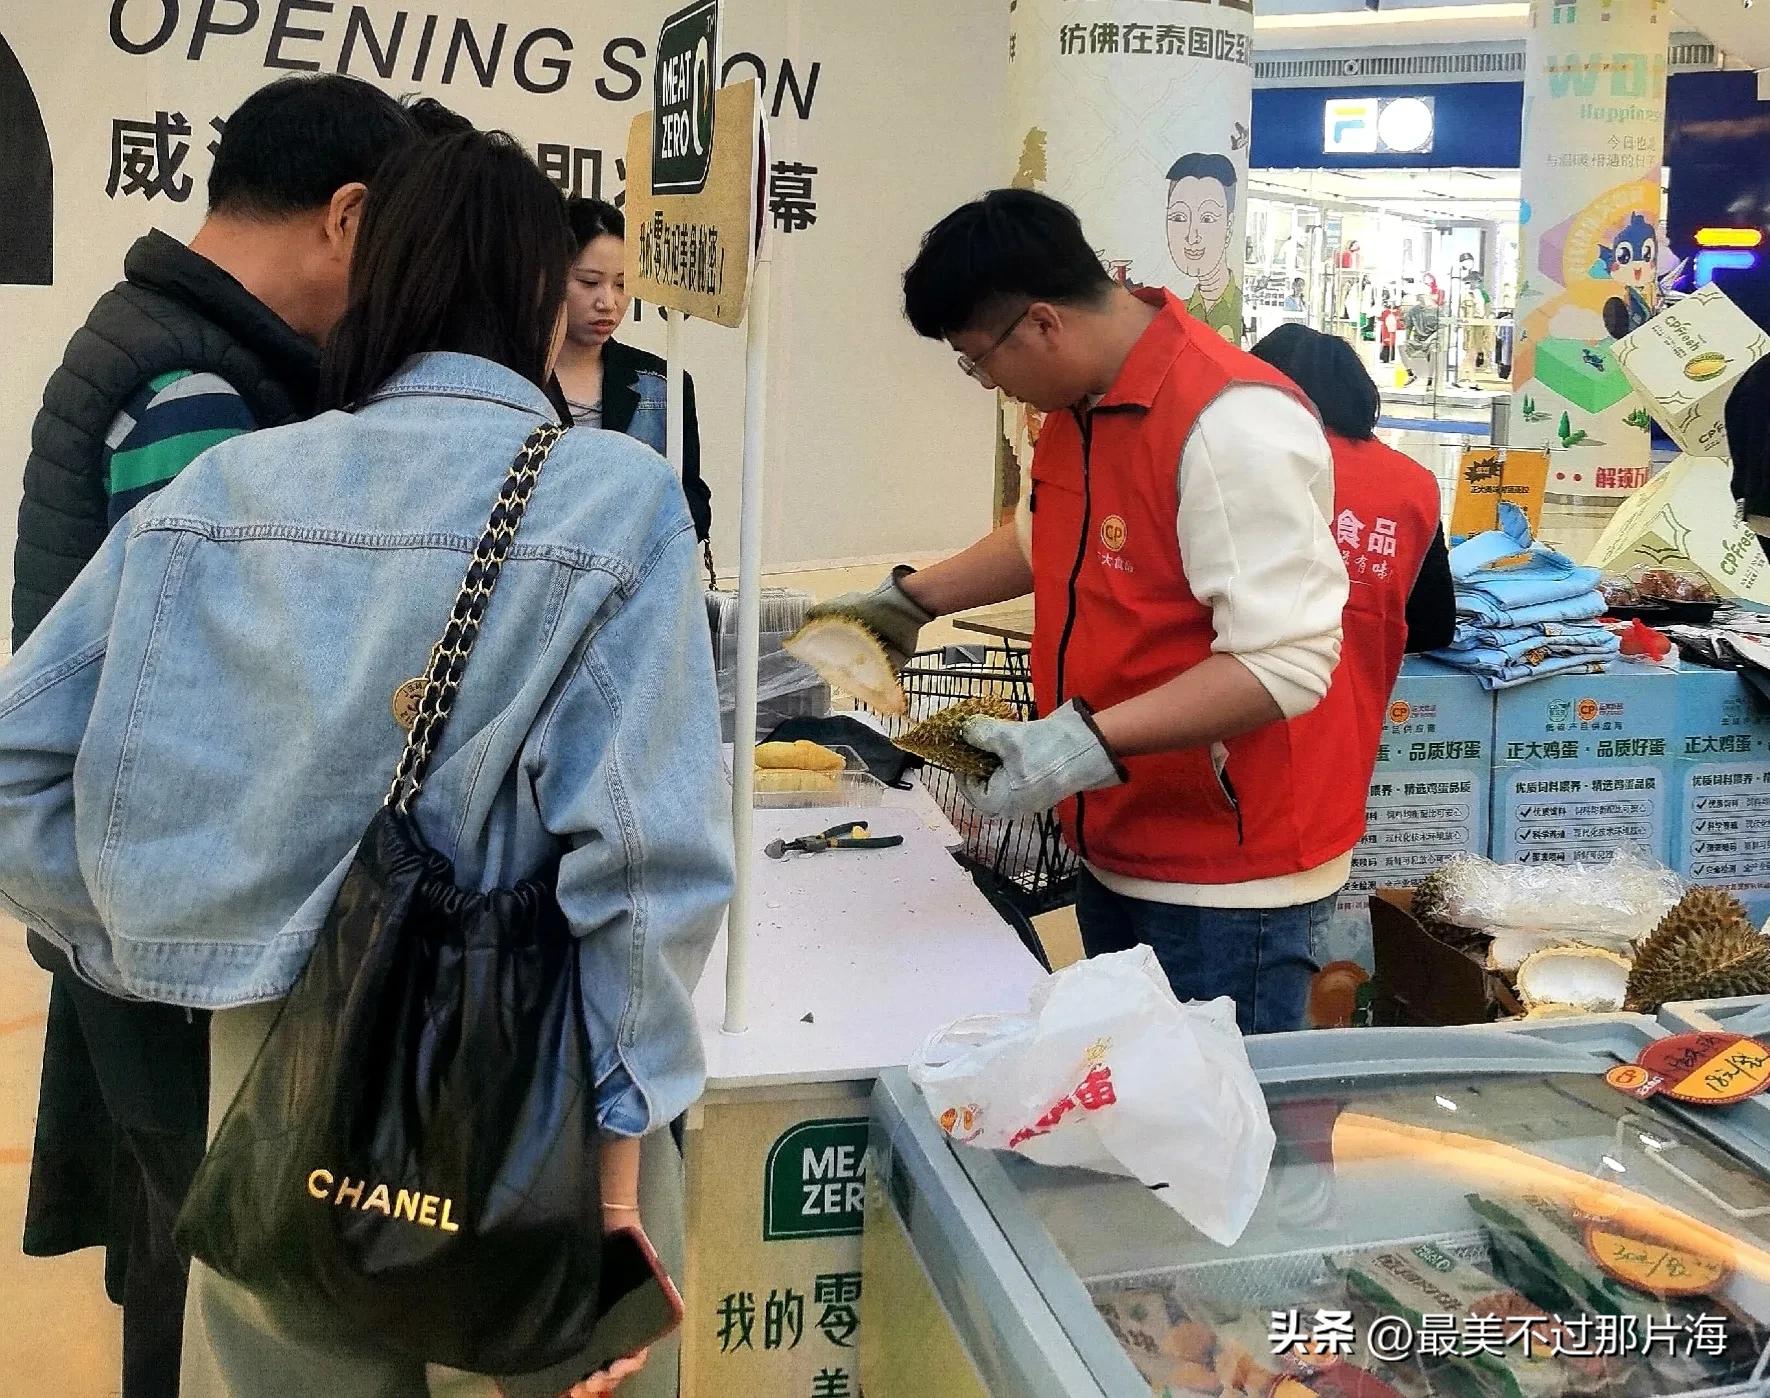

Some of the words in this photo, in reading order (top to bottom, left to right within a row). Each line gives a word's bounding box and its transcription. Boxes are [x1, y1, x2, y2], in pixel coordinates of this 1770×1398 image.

[109, 0, 574, 94] OPENING
[595, 37, 821, 120] SON
[662, 50, 692, 107] MEAT
[661, 109, 690, 158] ZERO
[1338, 509, 1397, 557] 食品
[1684, 734, 1770, 754] 正大鸡蛋·
[308, 1169, 459, 1233] CHANEL
[717, 1272, 862, 1353] 我的零
